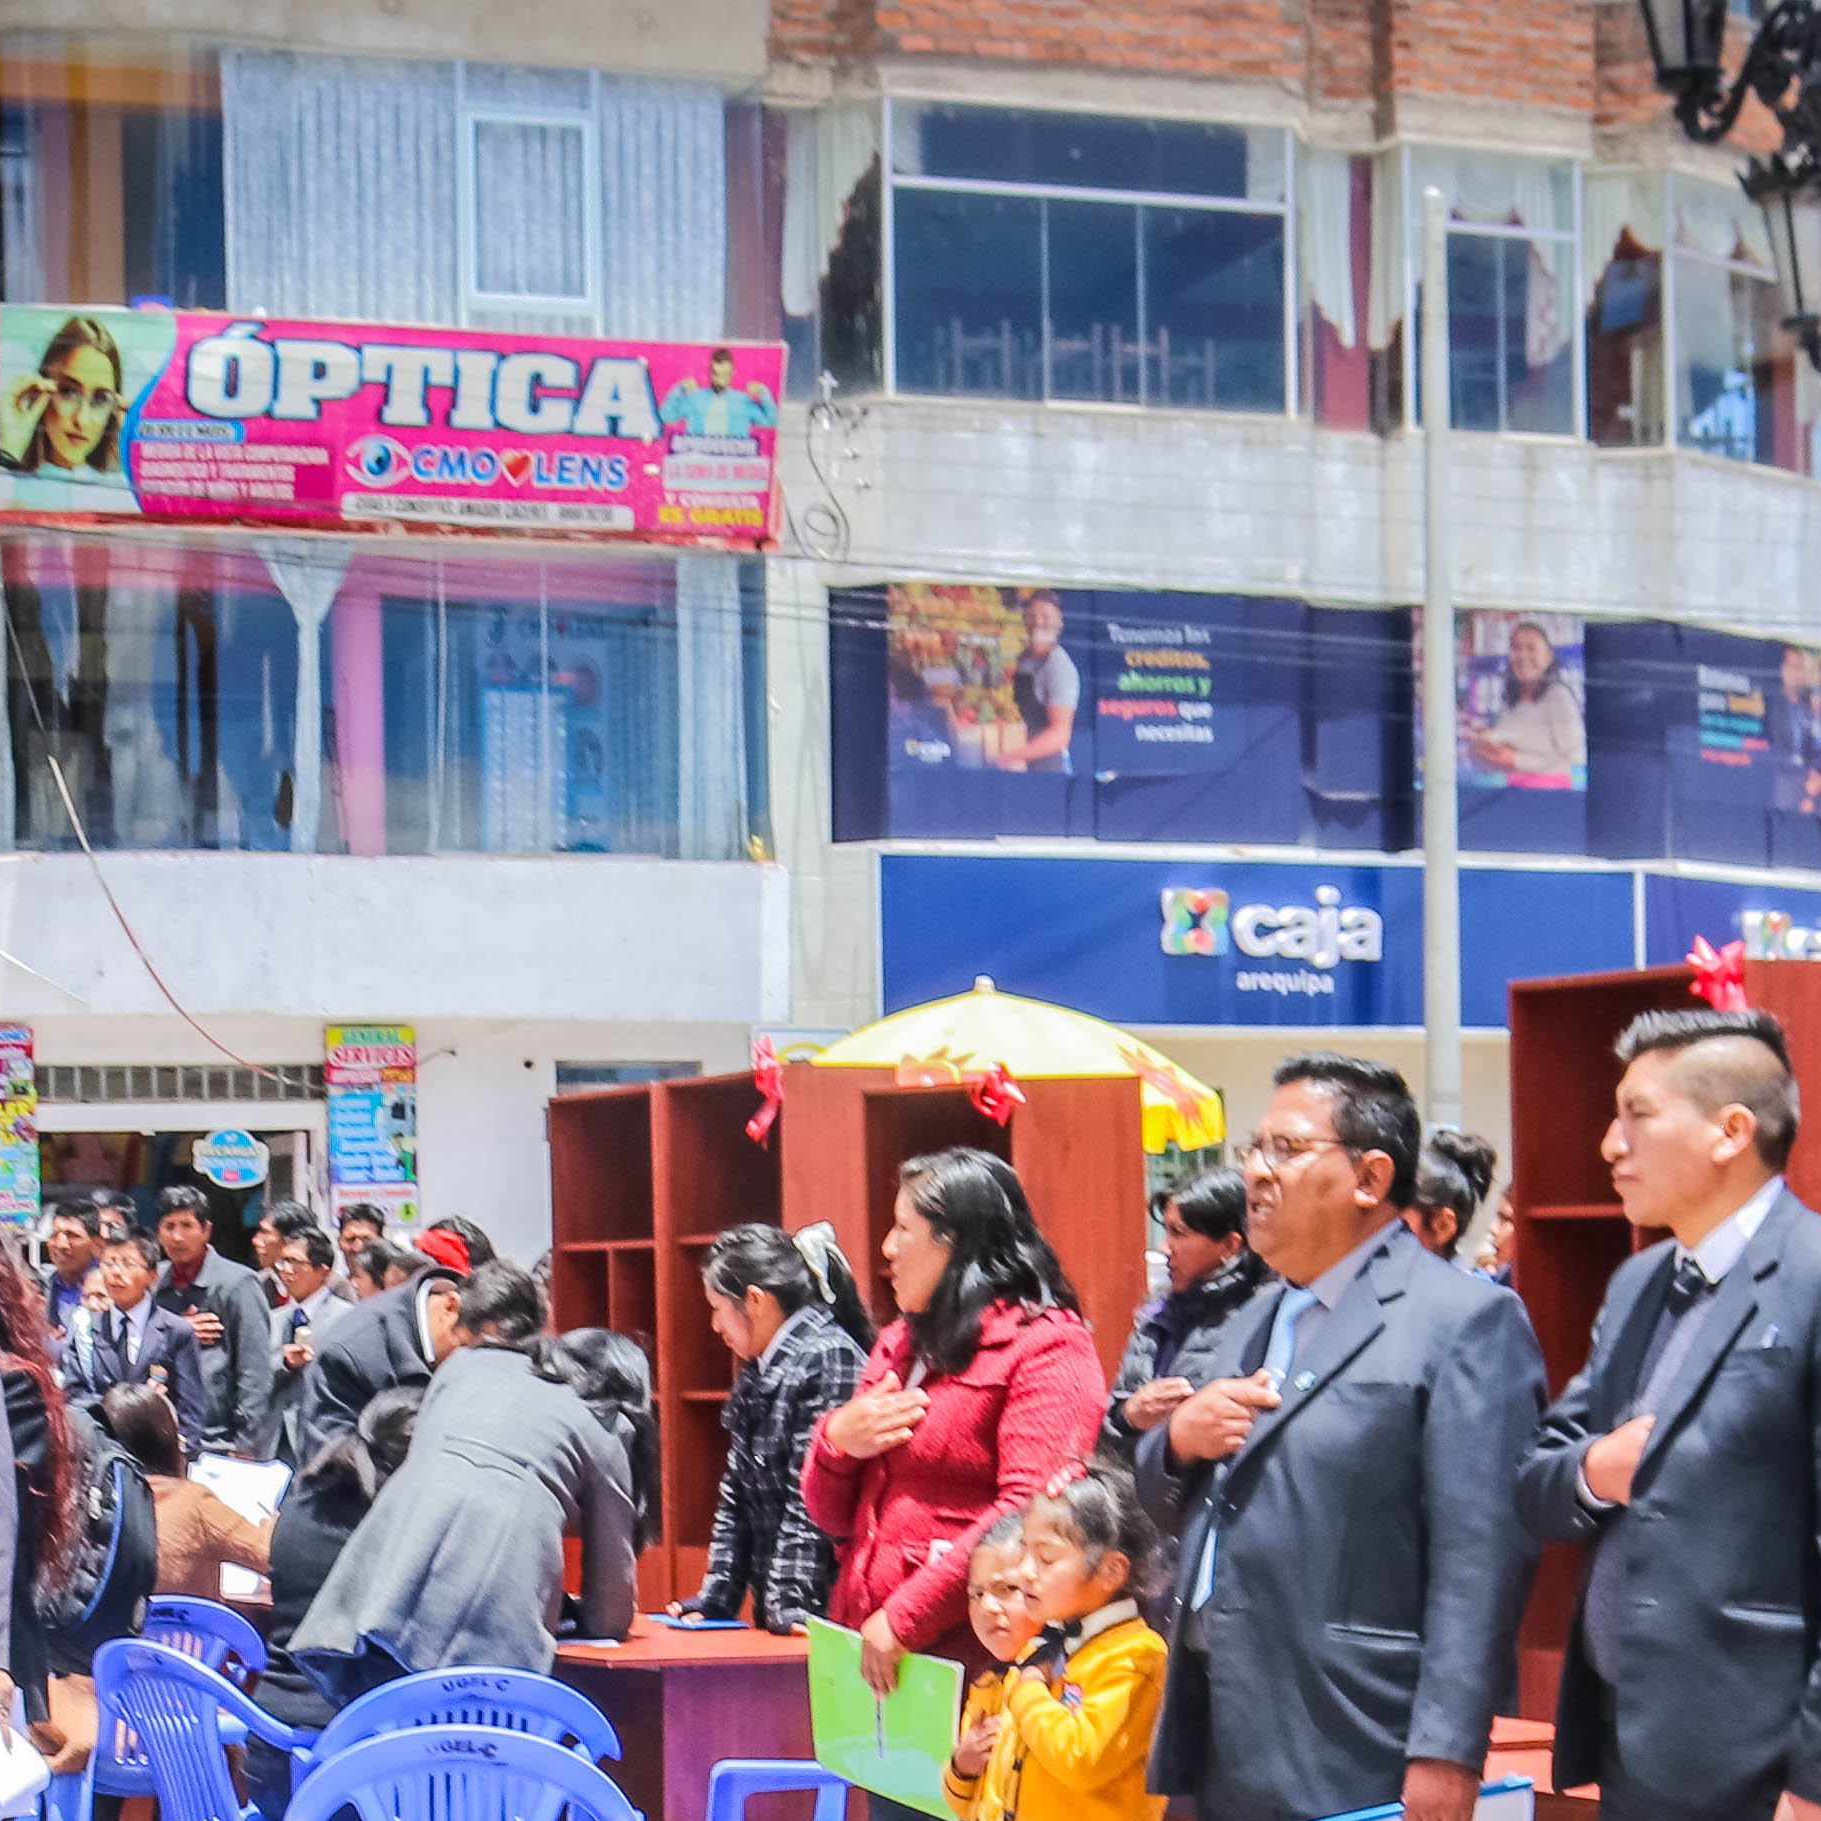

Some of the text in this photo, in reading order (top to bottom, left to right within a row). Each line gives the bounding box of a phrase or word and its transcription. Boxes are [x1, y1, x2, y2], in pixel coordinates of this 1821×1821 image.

[186, 322, 664, 440] ÓPTICA
[410, 446, 499, 484] CMO
[532, 450, 628, 489] LENS
[1231, 884, 1384, 970] caja
[1235, 968, 1335, 996] arequipa
